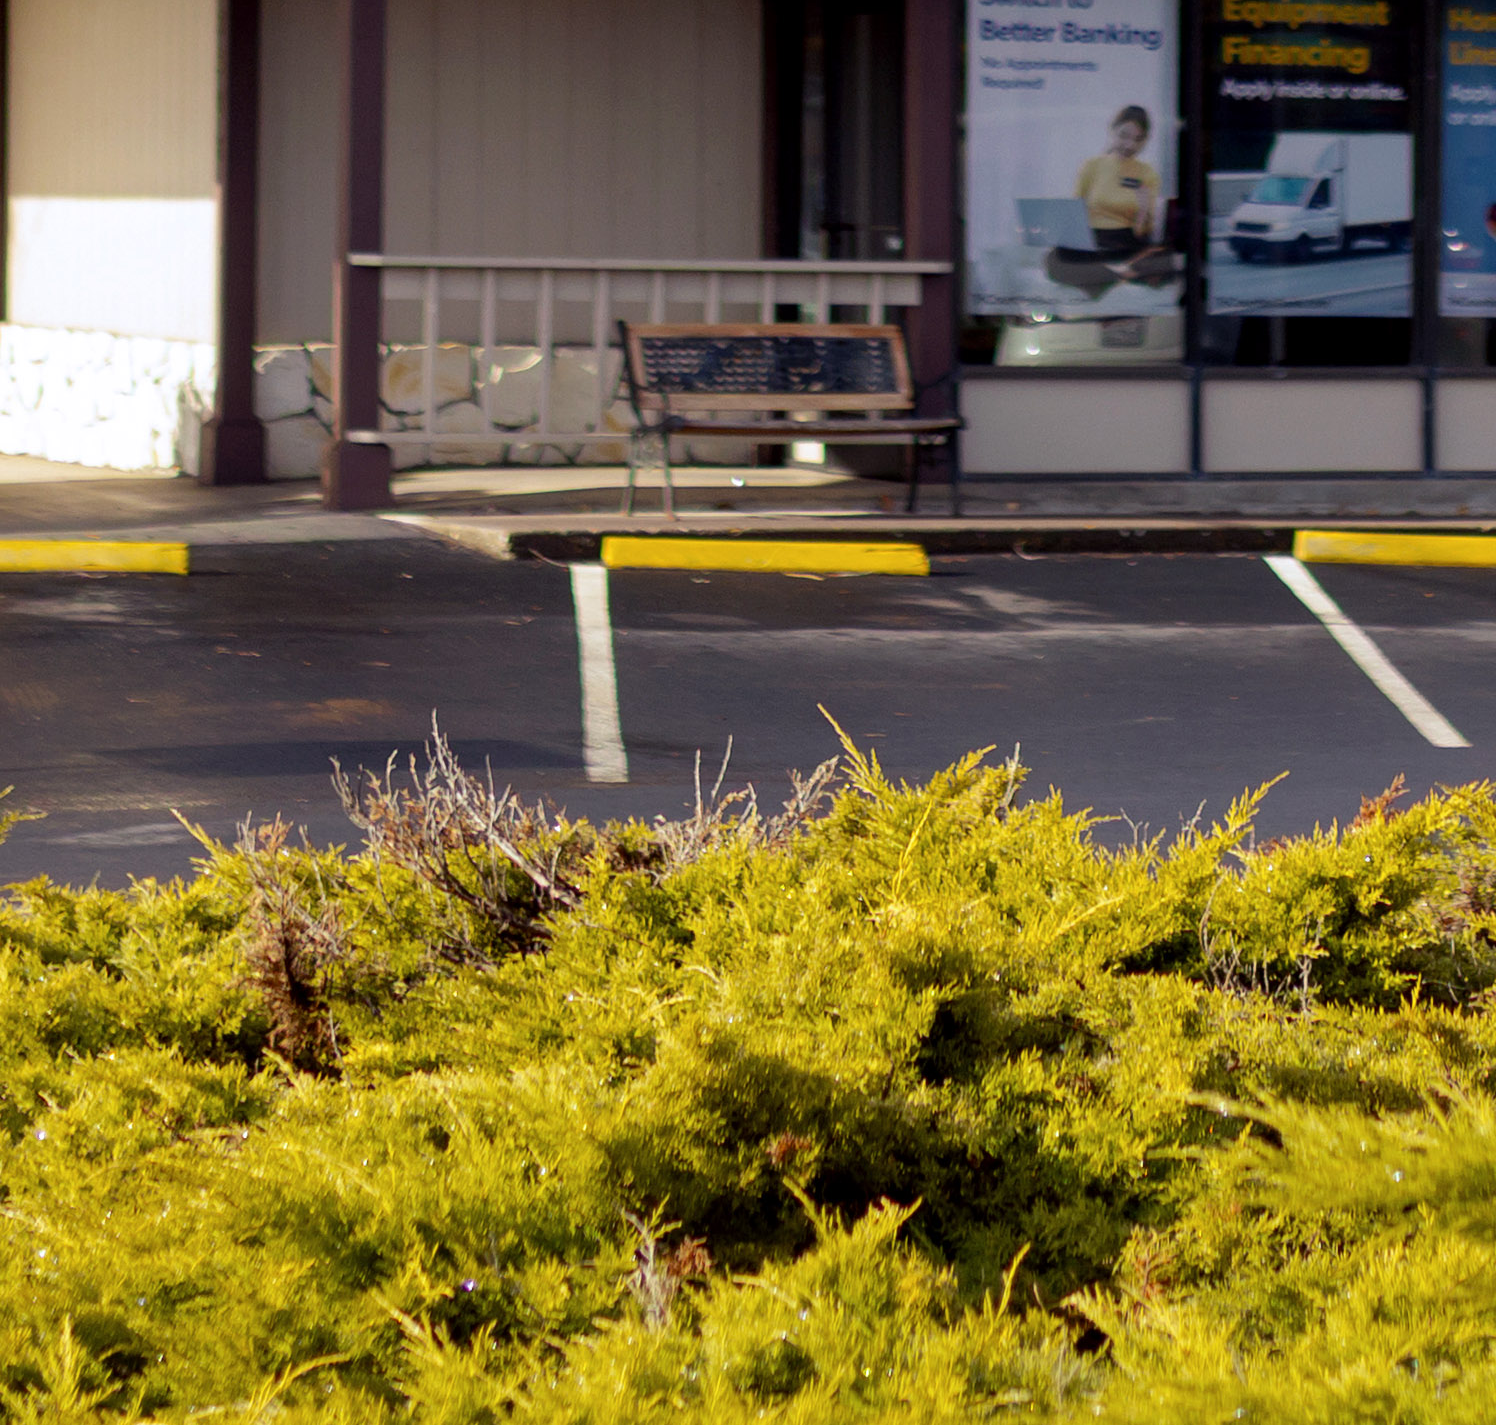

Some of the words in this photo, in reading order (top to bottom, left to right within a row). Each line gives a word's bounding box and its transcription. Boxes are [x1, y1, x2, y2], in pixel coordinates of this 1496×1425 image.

[979, 18, 1056, 41] Better
[1061, 21, 1163, 51] Banking
[1222, 36, 1371, 74] Financing
[1220, 79, 1273, 101] Apply
